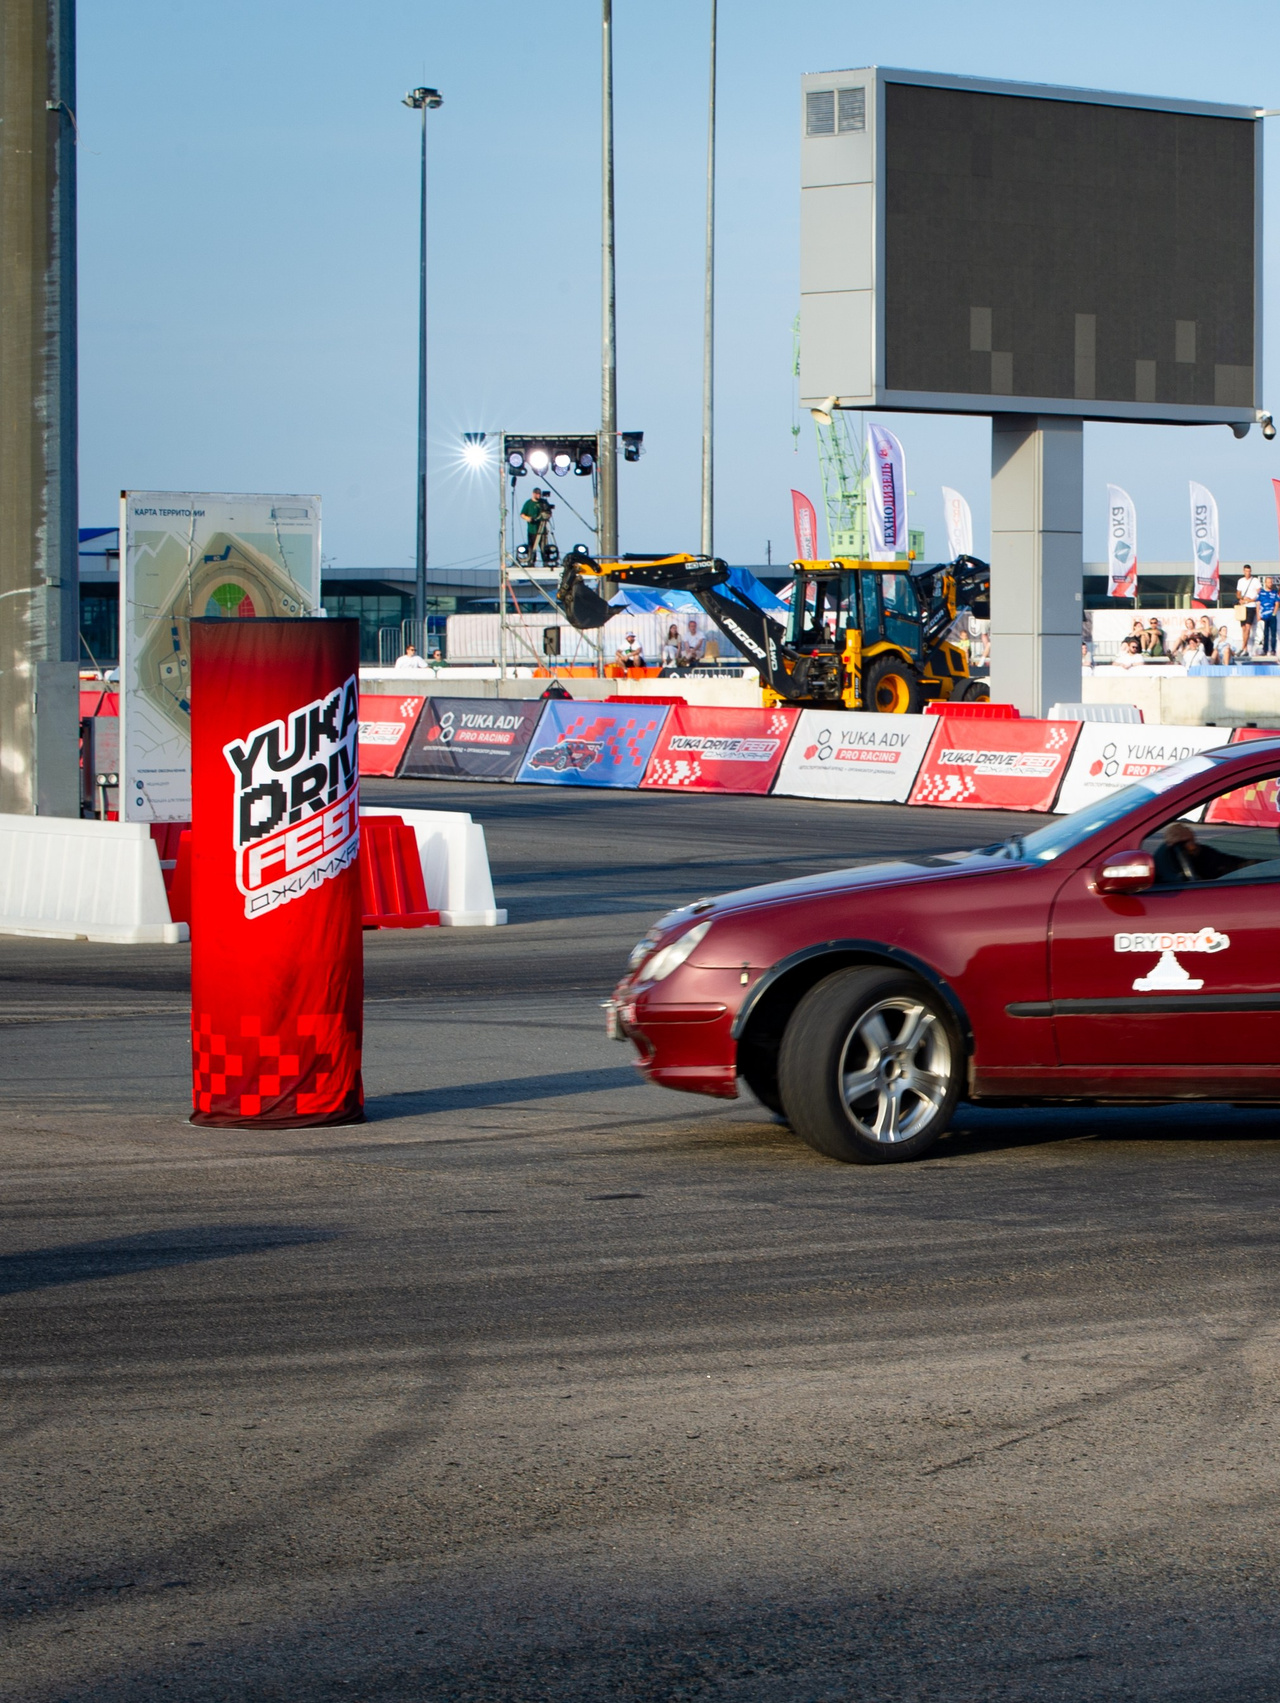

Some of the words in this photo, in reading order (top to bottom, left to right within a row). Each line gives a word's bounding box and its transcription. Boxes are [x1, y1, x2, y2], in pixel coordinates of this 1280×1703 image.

[134, 508, 157, 516] КАРТА
[159, 508, 206, 517] ТЕРРИТОИИ
[882, 463, 896, 546] ТЕХНОДИЗЕЛЬ
[723, 618, 766, 659] RIGOR
[460, 713, 494, 728] YUKA
[493, 715, 524, 730] ADV
[229, 681, 358, 790] YUKA
[459, 733, 477, 741] PRO
[478, 734, 510, 743] RACING
[841, 731, 876, 746] YUKA
[878, 732, 911, 747] ADV
[670, 738, 701, 749] YUKA
[701, 739, 741, 750] DRIVE
[1127, 744, 1164, 760] YUKA
[840, 750, 857, 760] PRO
[860, 751, 896, 762] RACING
[940, 751, 975, 763] YUKA
[976, 753, 1019, 766] DRIVE
[1126, 765, 1148, 775] PRO
[240, 726, 358, 846] DRIV
[250, 839, 358, 912] ДЖИМХА
[1119, 936, 1200, 949] DRYDRY
